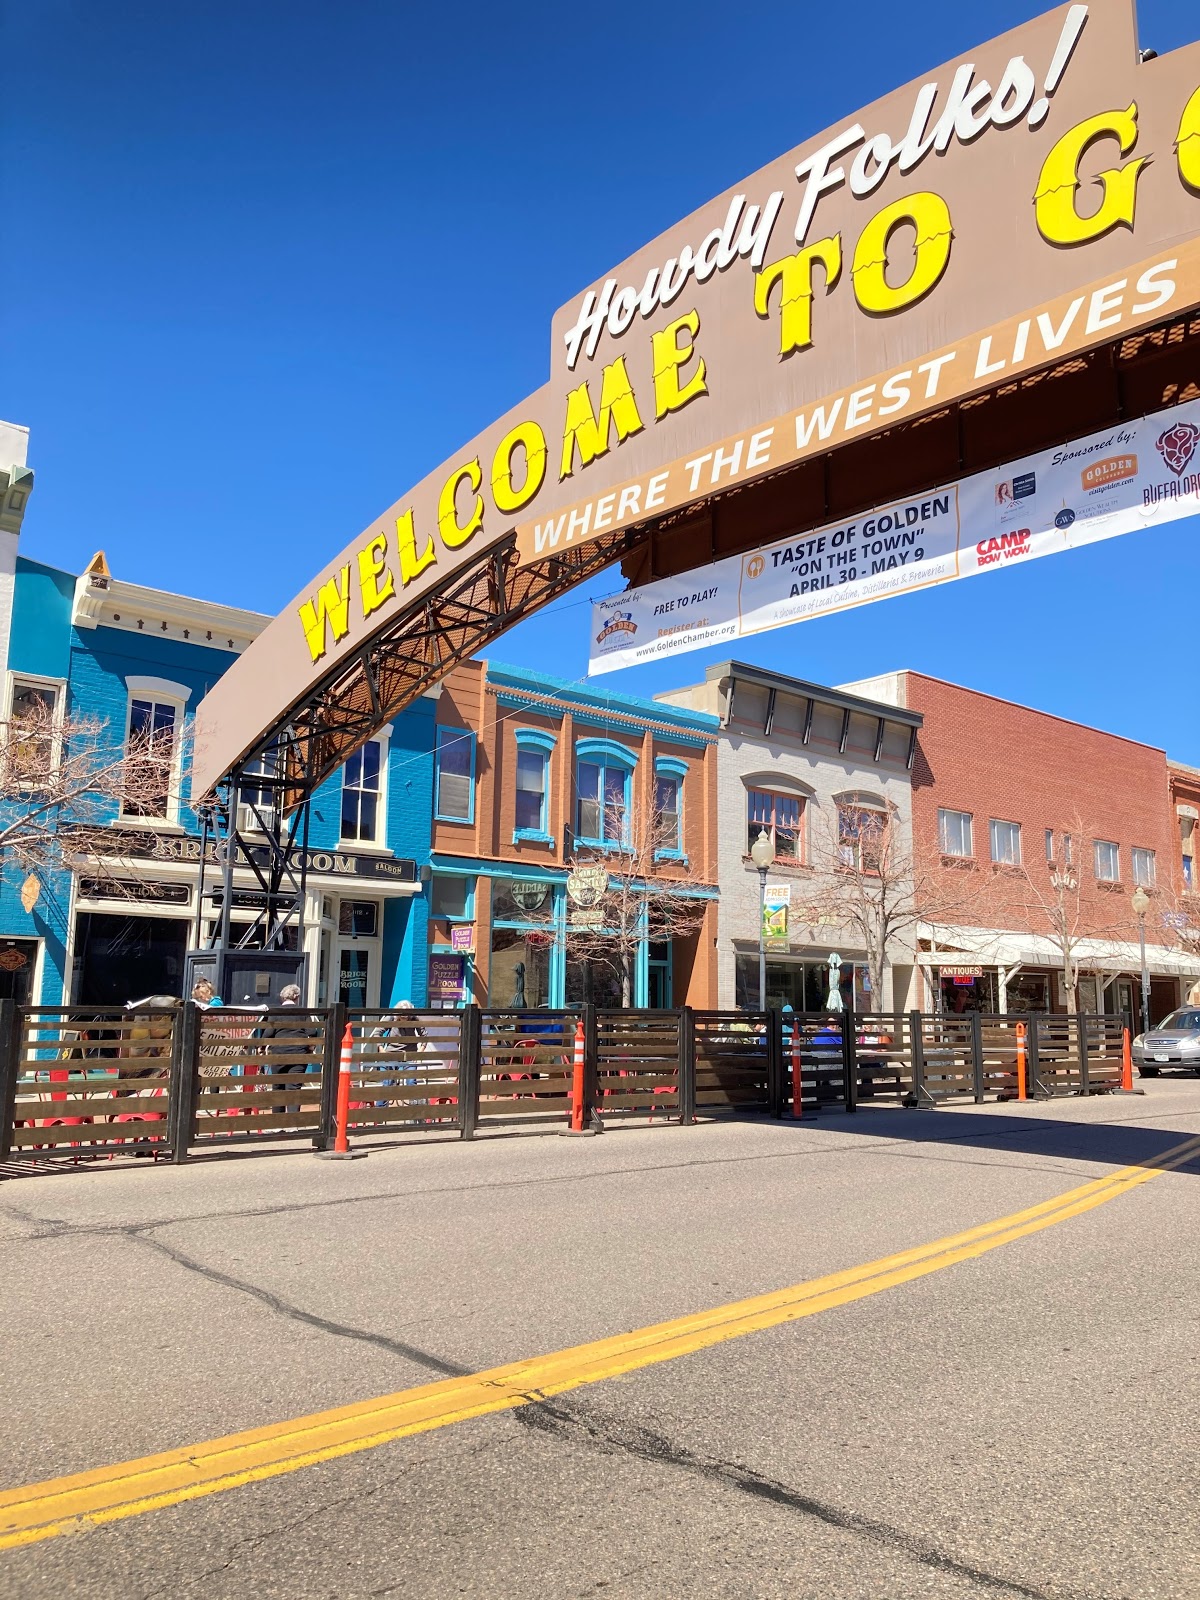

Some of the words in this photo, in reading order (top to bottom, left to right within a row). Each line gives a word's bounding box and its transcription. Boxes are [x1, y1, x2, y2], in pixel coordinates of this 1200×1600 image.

[565, 190, 784, 368] Howdy
[795, 4, 1088, 241] Folks!
[298, 308, 710, 663] WELCOME
[755, 191, 954, 355] TO
[1033, 83, 1200, 246] G
[534, 470, 670, 553] WHERE
[684, 427, 775, 494] THE
[792, 351, 956, 449] WEST
[973, 259, 1178, 379] LIVES
[1052, 435, 1115, 465] Sponsored
[1117, 431, 1137, 444] by:
[1086, 459, 1132, 480] GOLDEN
[771, 536, 826, 568] TASTE
[831, 526, 856, 547] OF
[862, 496, 950, 538] GOLDEN
[976, 528, 1031, 556] CAMP
[826, 548, 857, 568] THE
[977, 552, 1002, 567] BOW
[1003, 544, 1031, 559] WOW
[789, 575, 835, 598] APRIL
[839, 567, 857, 584] 30
[871, 550, 911, 576] MAY
[914, 547, 925, 562] 9
[815, 594, 833, 608] Local
[909, 563, 945, 582] Breweries
[600, 595, 631, 611] Presented
[632, 592, 643, 603] by:
[653, 602, 676, 616] FREE
[677, 597, 689, 609] TO
[690, 586, 719, 605] PLAY!
[600, 621, 635, 640] GOLDEN
[657, 620, 695, 638] Register
[697, 617, 710, 628] at:
[636, 624, 736, 657] www.GoldenChamber.org
[375, 862, 402, 875] SALOON
[766, 887, 789, 897] FREE
[340, 970, 367, 978] BRICK
[432, 961, 459, 970] GOLDEN
[433, 970, 459, 979] PUZZLE
[942, 966, 980, 975] ANTIQUES
[340, 980, 366, 989] ROOM
[437, 980, 458, 988] ROOM
